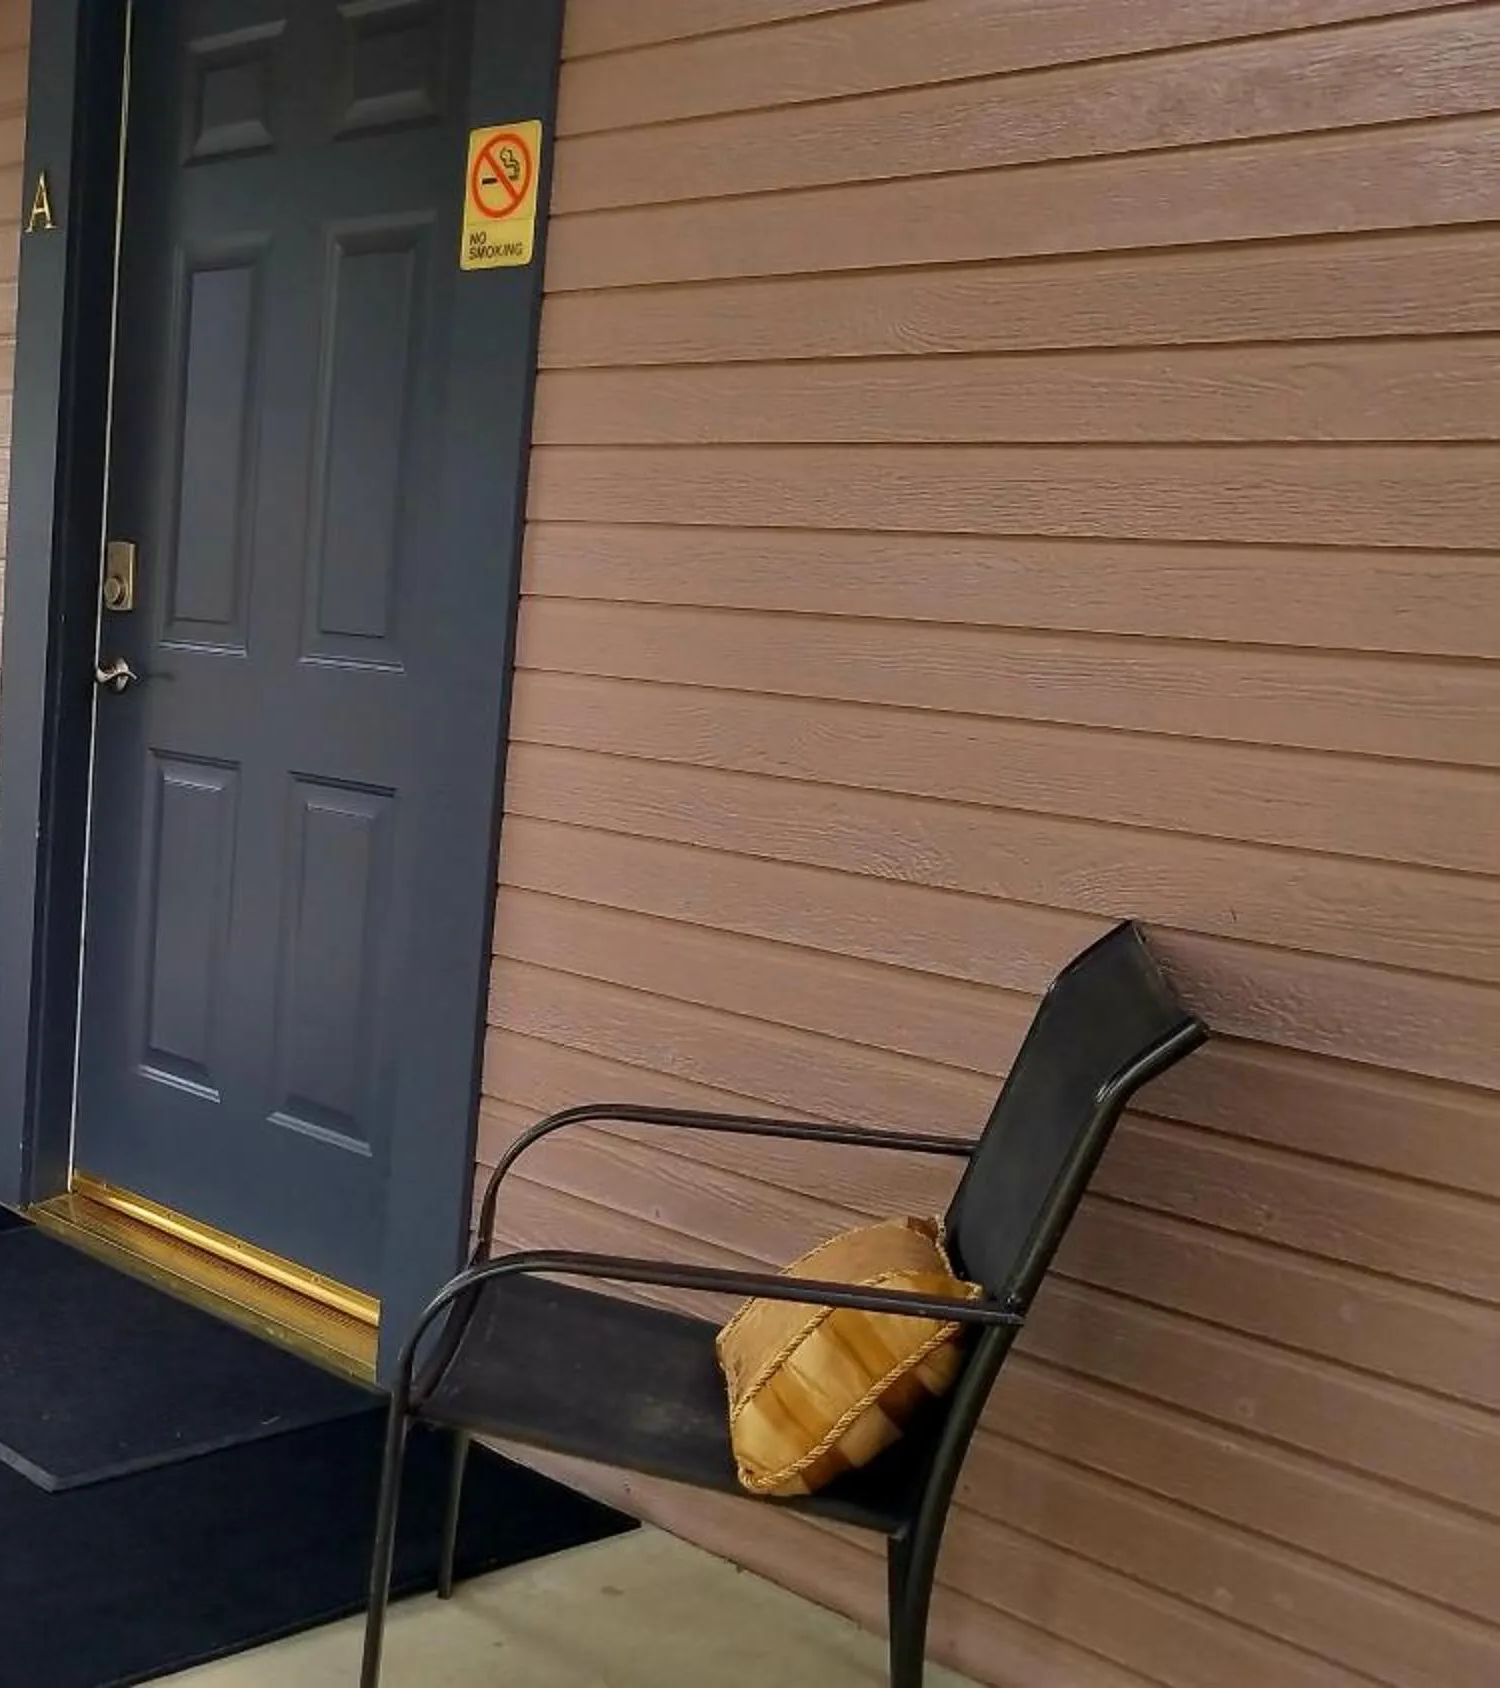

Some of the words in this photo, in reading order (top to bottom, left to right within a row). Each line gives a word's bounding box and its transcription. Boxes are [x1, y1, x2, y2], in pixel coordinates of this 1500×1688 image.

[24, 169, 58, 233] A
[469, 231, 487, 245] NO
[469, 242, 523, 260] SMOKING
